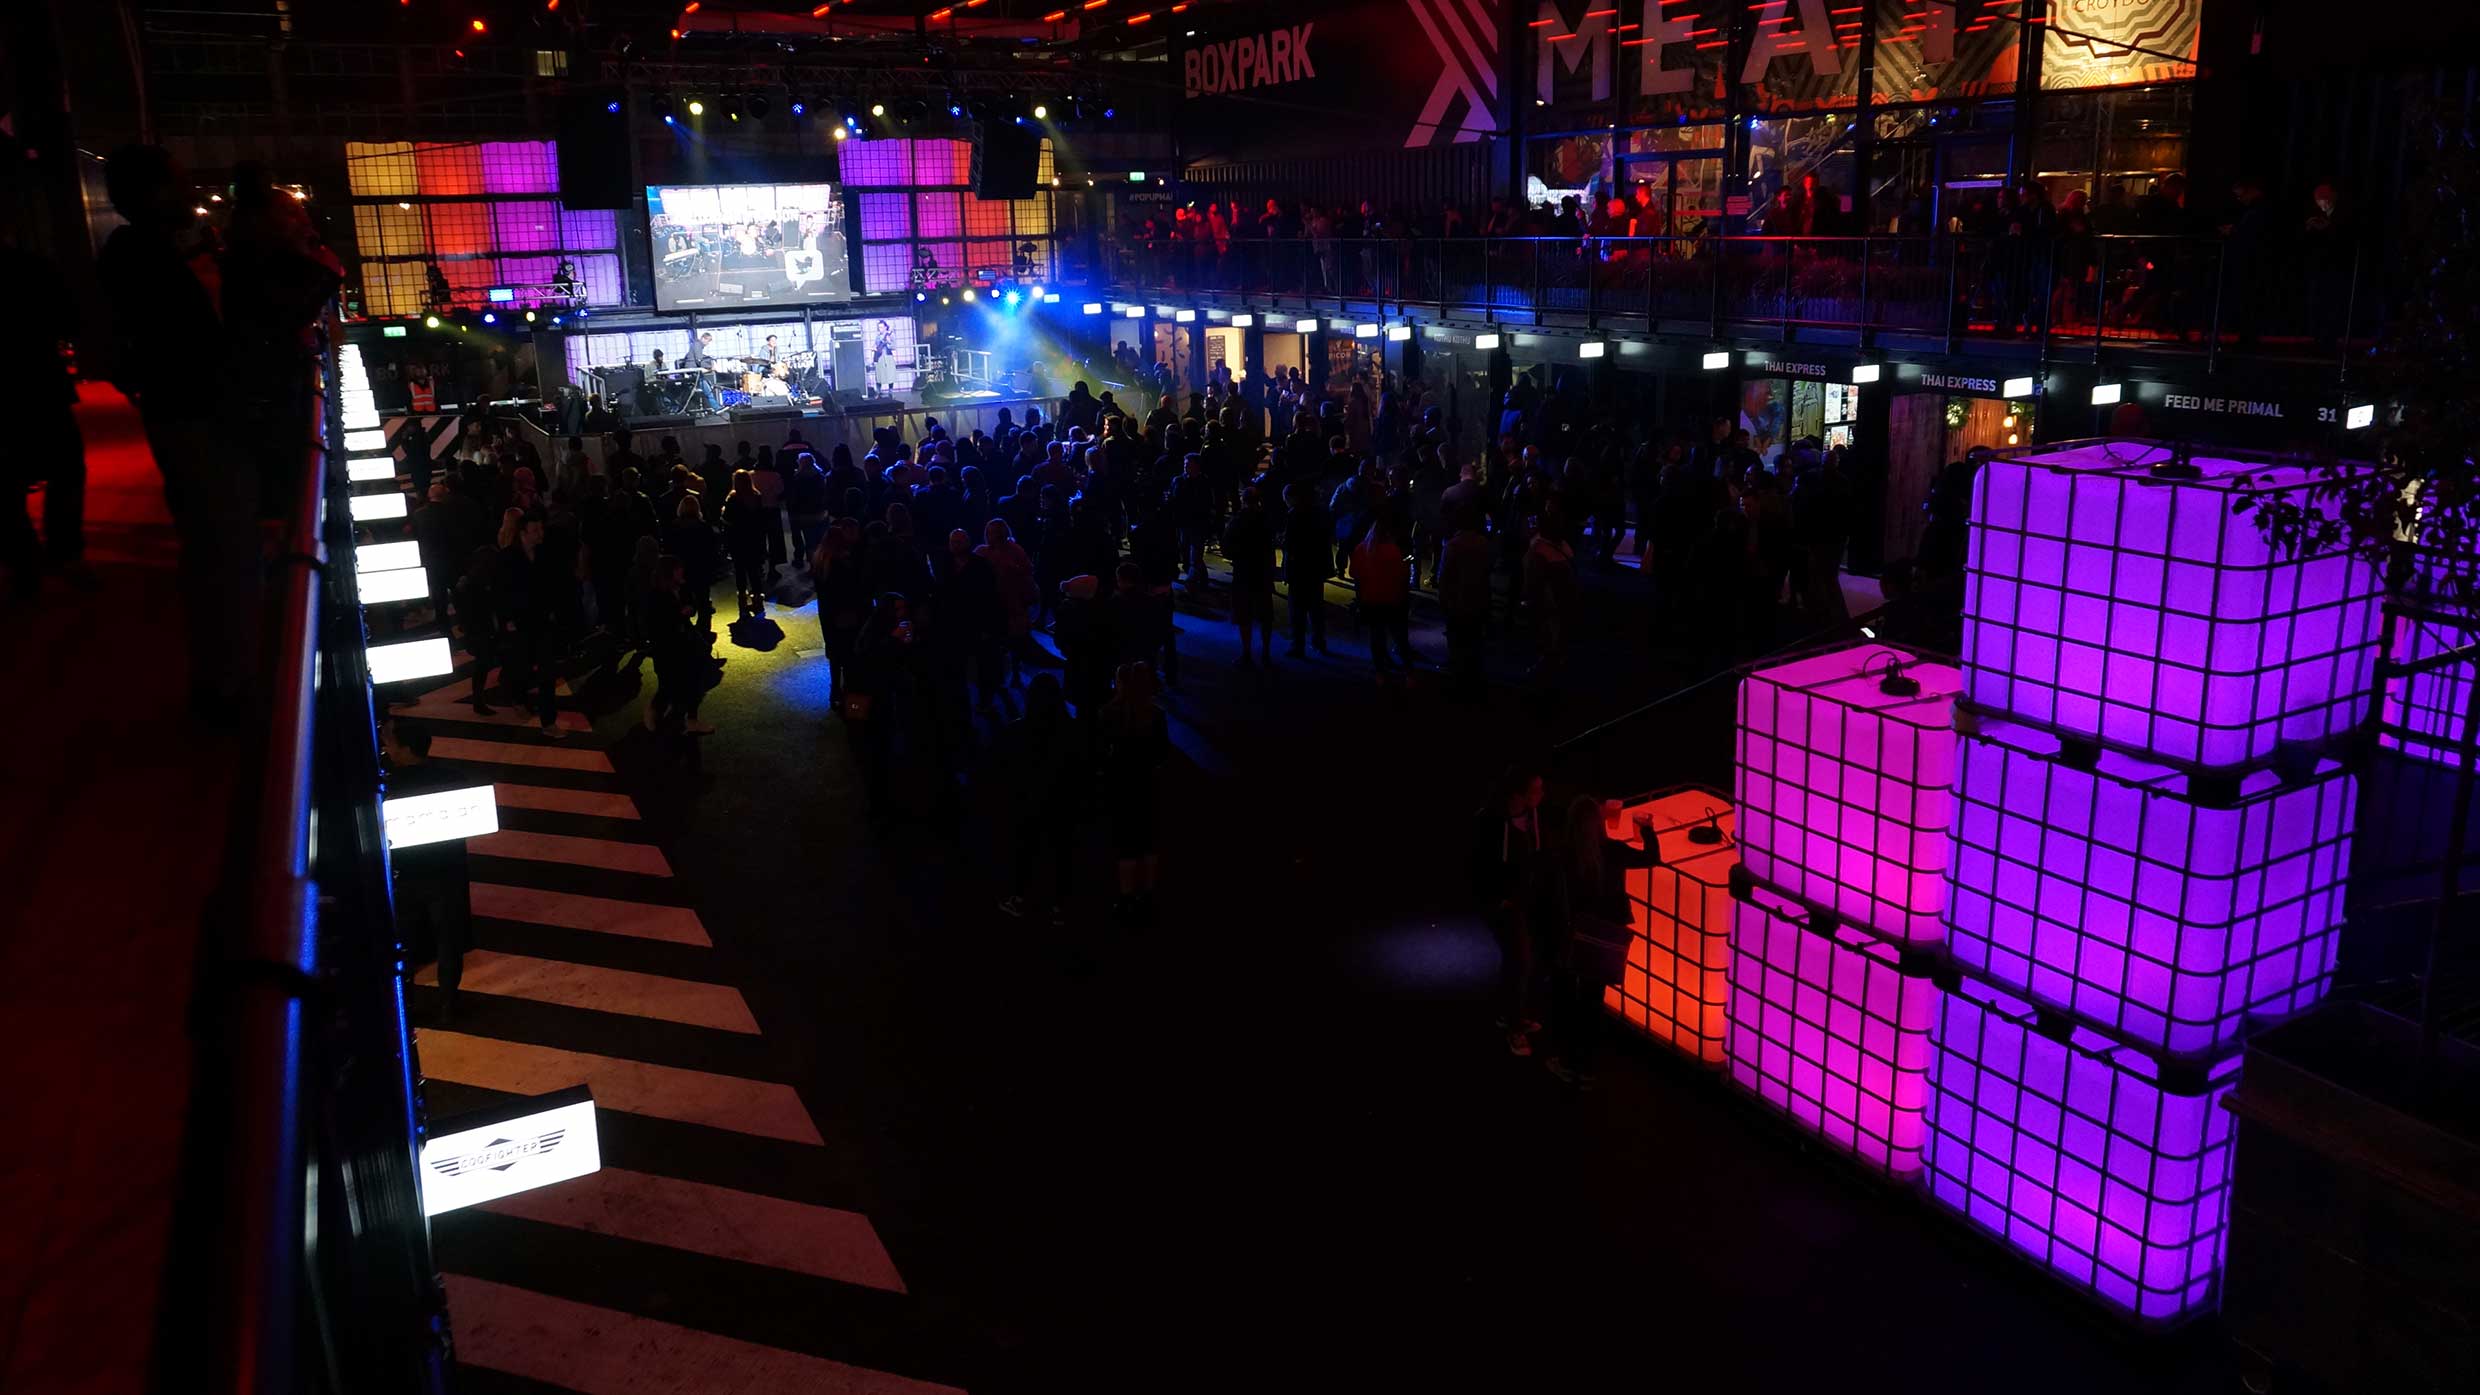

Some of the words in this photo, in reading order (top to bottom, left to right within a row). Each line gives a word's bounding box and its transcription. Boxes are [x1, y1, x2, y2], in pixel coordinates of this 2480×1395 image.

[1184, 21, 1316, 100] BOXPARK
[1764, 360, 1784, 373] THAI
[1785, 362, 1827, 376] EXPRESS
[1921, 373, 1945, 388] THAI
[1947, 375, 1997, 392] EXPRESS
[2164, 393, 2201, 411] FEED
[2204, 397, 2225, 413] ME
[2228, 399, 2285, 418] PRIMAL
[2317, 406, 2338, 422] 31
